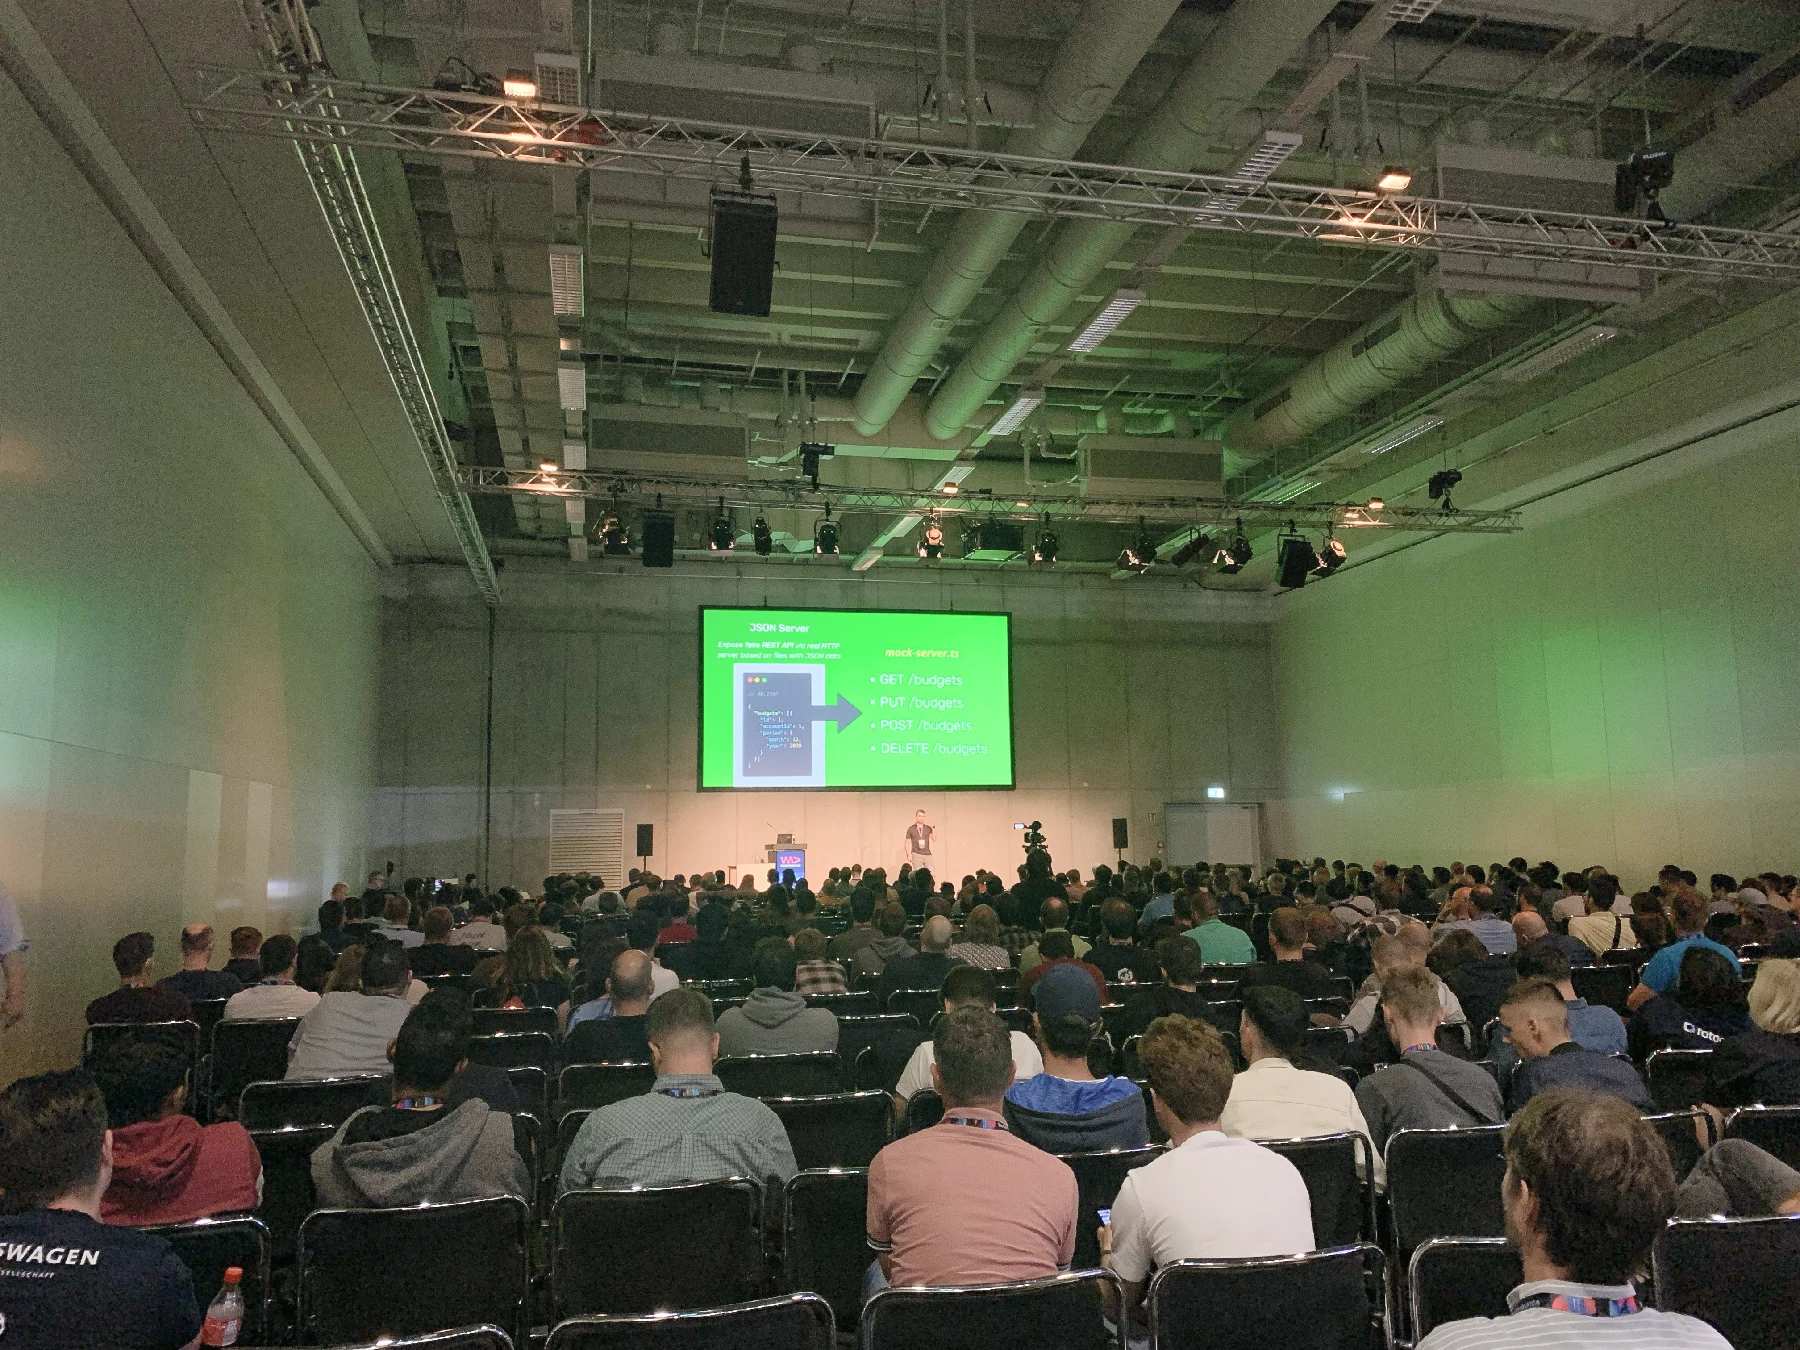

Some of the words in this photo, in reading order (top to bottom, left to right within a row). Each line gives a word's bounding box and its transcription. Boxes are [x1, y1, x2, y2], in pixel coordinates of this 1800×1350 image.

[749, 623, 776, 632] JSON
[778, 624, 810, 633] Server
[717, 641, 743, 650] Expose
[884, 648, 960, 659] mock-server.ts
[880, 674, 904, 685] GET
[908, 673, 963, 688] /budgets
[880, 696, 905, 708] PUT
[909, 696, 964, 711] /budgets
[880, 719, 914, 731] POST
[917, 719, 972, 734] /budgets
[881, 742, 929, 754] DELETE
[932, 741, 988, 757] /budgets
